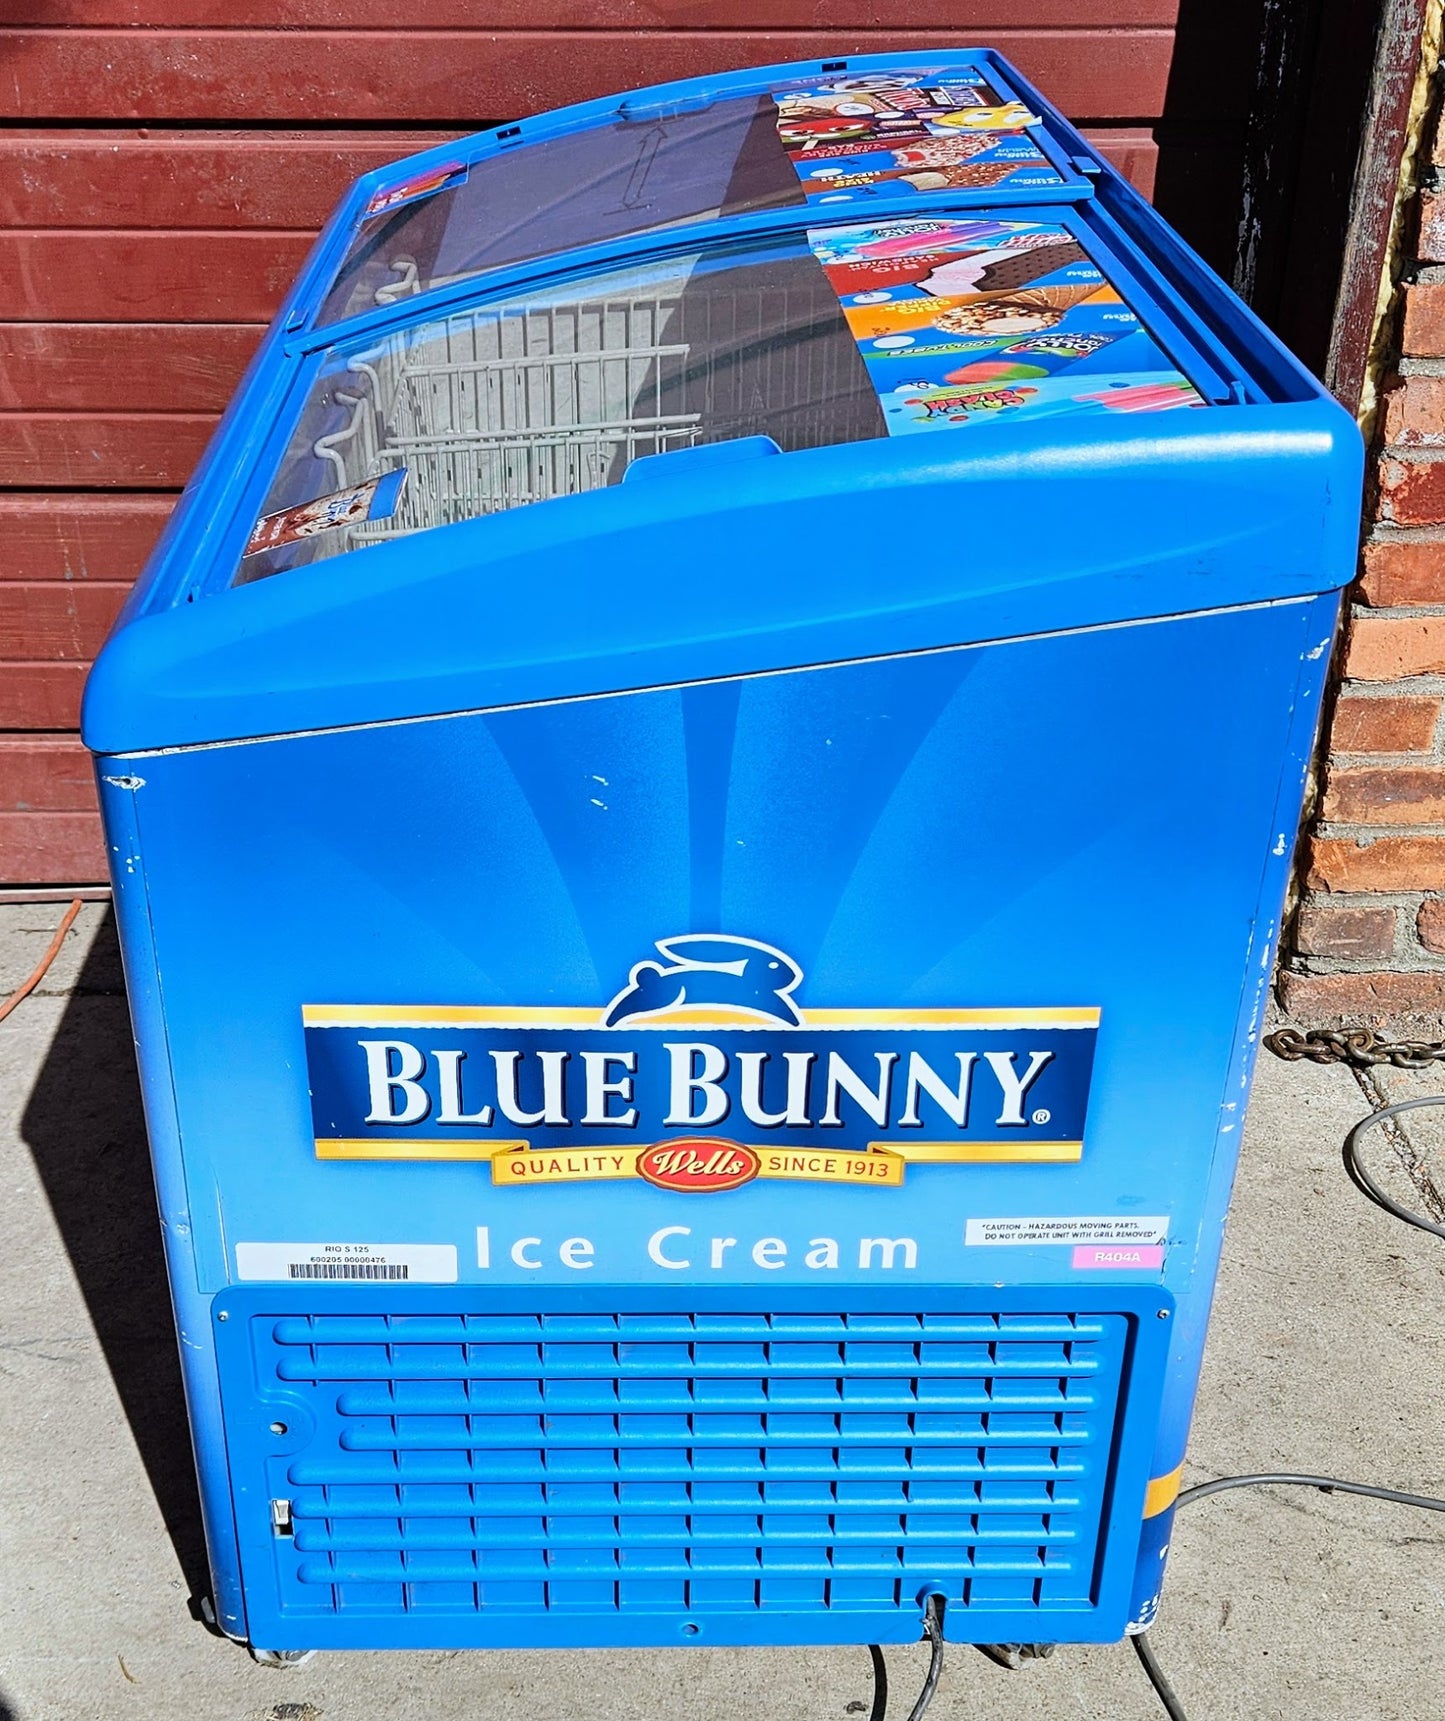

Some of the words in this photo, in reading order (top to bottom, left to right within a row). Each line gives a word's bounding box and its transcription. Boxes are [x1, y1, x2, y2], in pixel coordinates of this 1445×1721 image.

[357, 1040, 639, 1129] BLUE
[511, 1156, 625, 1177] QUALITY
[652, 1149, 746, 1176] Wells
[768, 1156, 837, 1174] SINCE
[846, 1160, 889, 1178] 1913
[1028, 1222, 1078, 1230] HAZARDOUS
[985, 1232, 998, 1240] DO
[999, 1232, 1016, 1240] NOT
[344, 1245, 351, 1253] S
[354, 1245, 370, 1253] 125
[475, 1225, 596, 1270] Ice
[647, 1225, 919, 1270] Cream
[1095, 1251, 1142, 1262] R404A
